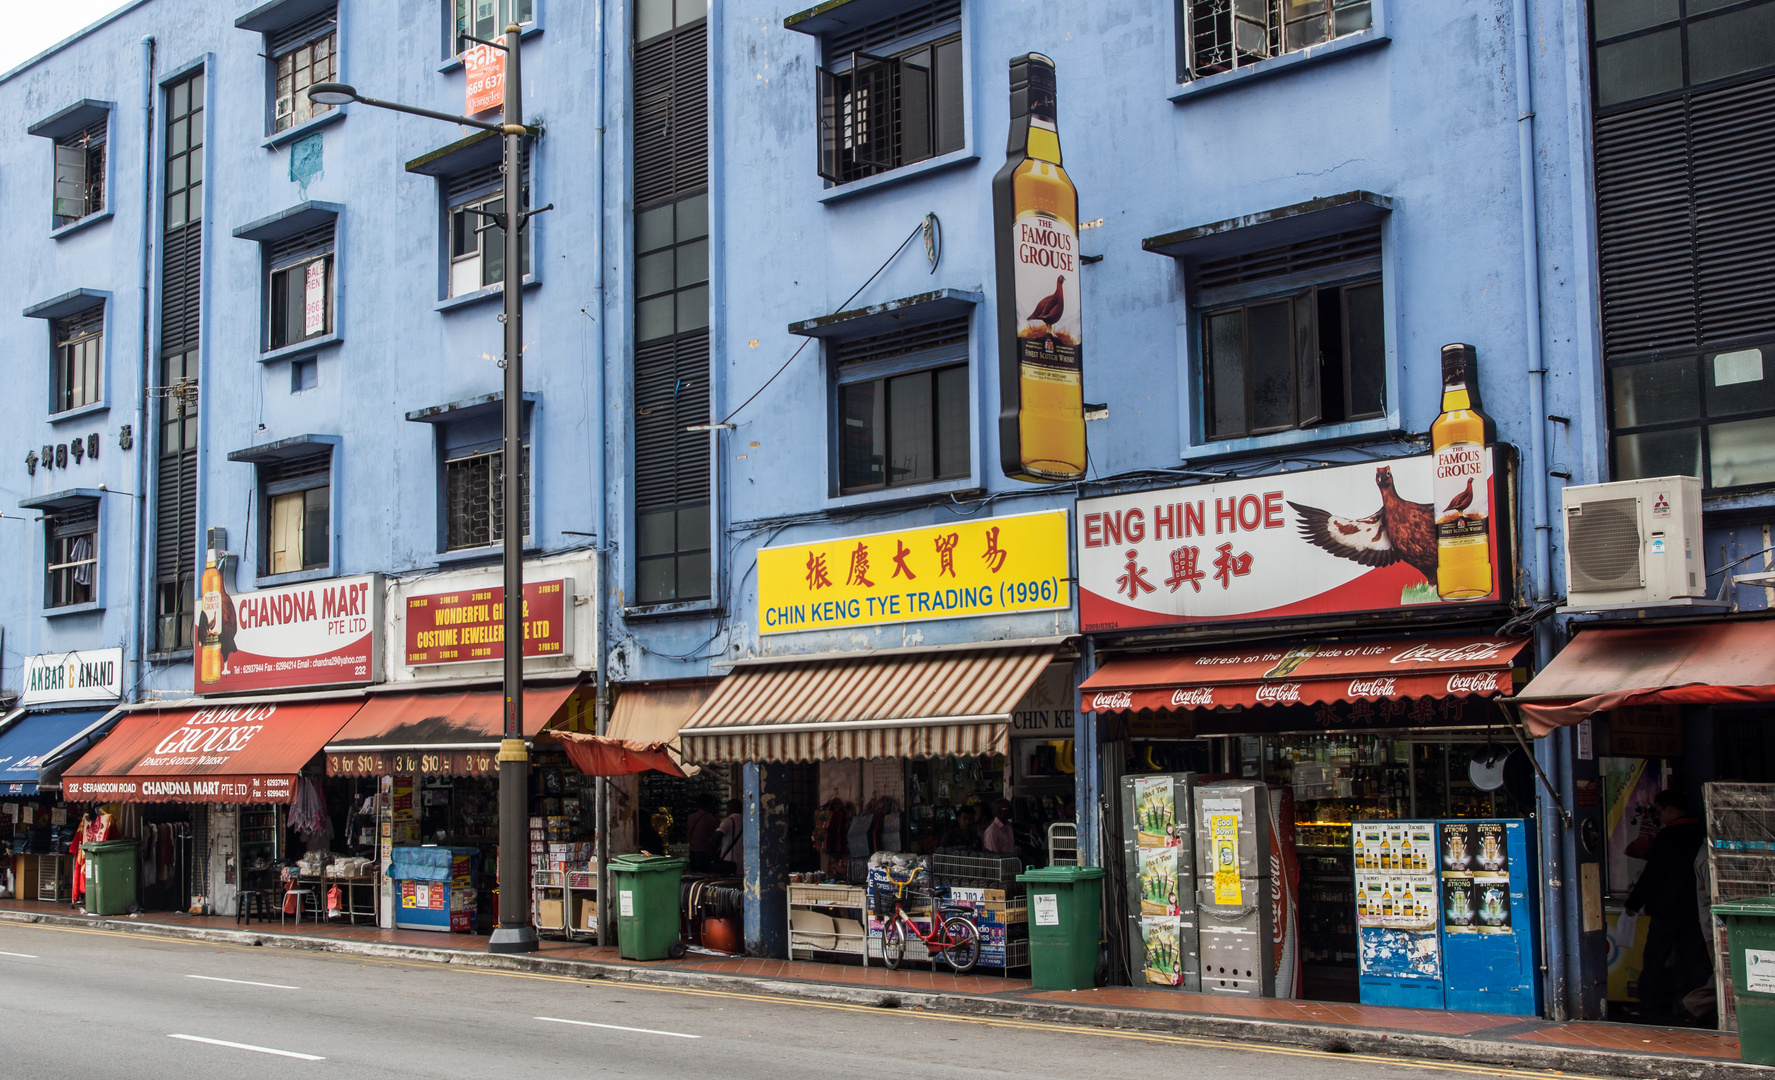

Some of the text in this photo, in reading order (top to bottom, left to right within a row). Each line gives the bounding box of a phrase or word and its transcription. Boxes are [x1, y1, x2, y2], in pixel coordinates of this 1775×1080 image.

[1038, 219, 1052, 228] THE
[1021, 224, 1071, 251] FAMOUS
[1020, 244, 1074, 272] GROUSE
[1438, 450, 1480, 466] FAMOUS
[1437, 462, 1482, 479] GROUSE
[1084, 491, 1285, 548] ENG HIN HOE
[805, 526, 1007, 591] 振慶大貿易
[1116, 542, 1254, 601] 永興和
[239, 582, 368, 630] CHANDNA MART
[766, 576, 1058, 626] CHIN KENG TYE TRADING (1996)
[436, 605, 489, 626] WONDERFUL
[328, 617, 367, 636] PTE LTD
[417, 629, 458, 648] COSTUME
[461, 625, 504, 645] JEWELLER
[533, 620, 549, 638] LTD
[1195, 656, 1240, 666] Refresh
[1244, 655, 1259, 663] on
[1262, 653, 1281, 662] the
[1316, 649, 1343, 658] side
[1345, 647, 1358, 657] of
[1389, 641, 1515, 664] Coca-Cola
[243, 663, 264, 674] 62937944
[264, 663, 273, 672] Fax
[276, 660, 296, 671] 62994214
[297, 659, 310, 668] Email
[313, 655, 366, 668] chandna29@yahoo.com
[354, 666, 366, 676] 232
[31, 665, 64, 691] AKBAR
[78, 660, 114, 688] ANAND
[1446, 672, 1499, 693] Coca-Cola
[1171, 686, 1214, 706] Coca-Cola
[1256, 683, 1300, 702] Coca-Cola
[1348, 677, 1396, 697] Coca-Cola
[1092, 690, 1133, 709] Coca-Cola
[186, 702, 277, 725] FAMOUS
[1014, 711, 1049, 729] CHIN
[154, 725, 263, 755] GROUSE
[139, 755, 230, 767] FINEST SCOTCH WHISKY
[333, 758, 338, 772] 3
[342, 757, 354, 772] for
[396, 757, 402, 772] 3
[466, 756, 473, 771] 3
[476, 755, 490, 771] for
[69, 783, 78, 793] 232
[83, 783, 118, 793] SERANGOON
[119, 783, 136, 793] ROAD
[142, 782, 191, 795] CHANDNA
[193, 781, 220, 795] MART
[221, 784, 234, 795] PTE
[235, 784, 247, 795] LTD
[267, 778, 289, 786] 62937944
[1215, 827, 1235, 835] down
[1217, 818, 1233, 826] Cool
